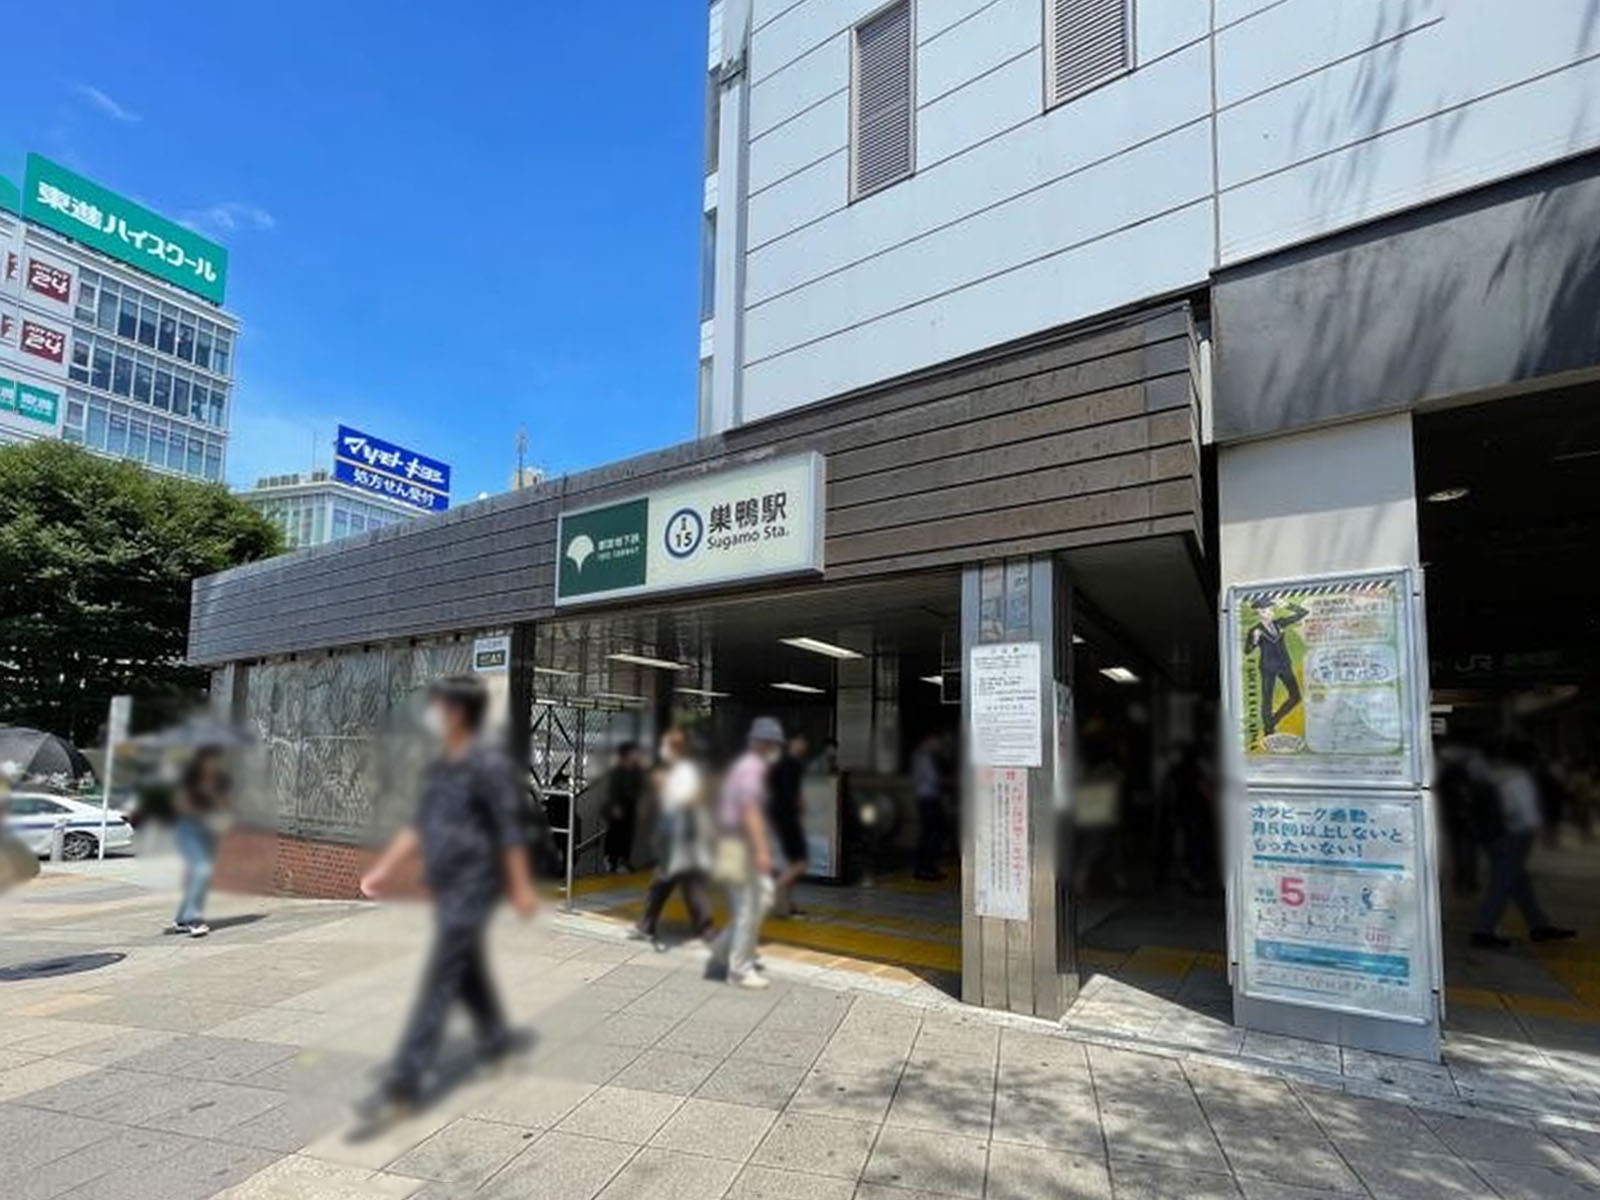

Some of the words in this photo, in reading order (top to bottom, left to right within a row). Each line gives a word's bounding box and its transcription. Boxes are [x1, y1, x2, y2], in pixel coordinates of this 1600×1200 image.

[37, 181, 217, 283] 東進ハイスクール
[31, 271, 68, 295] 24
[25, 332, 62, 355] 24
[353, 467, 436, 507] 処方せん受付
[708, 491, 788, 534] 巣鴨駅
[675, 531, 693, 549] 15
[706, 530, 760, 551] Sugamo
[763, 525, 790, 540] Sta.
[1280, 876, 1306, 907] 5
